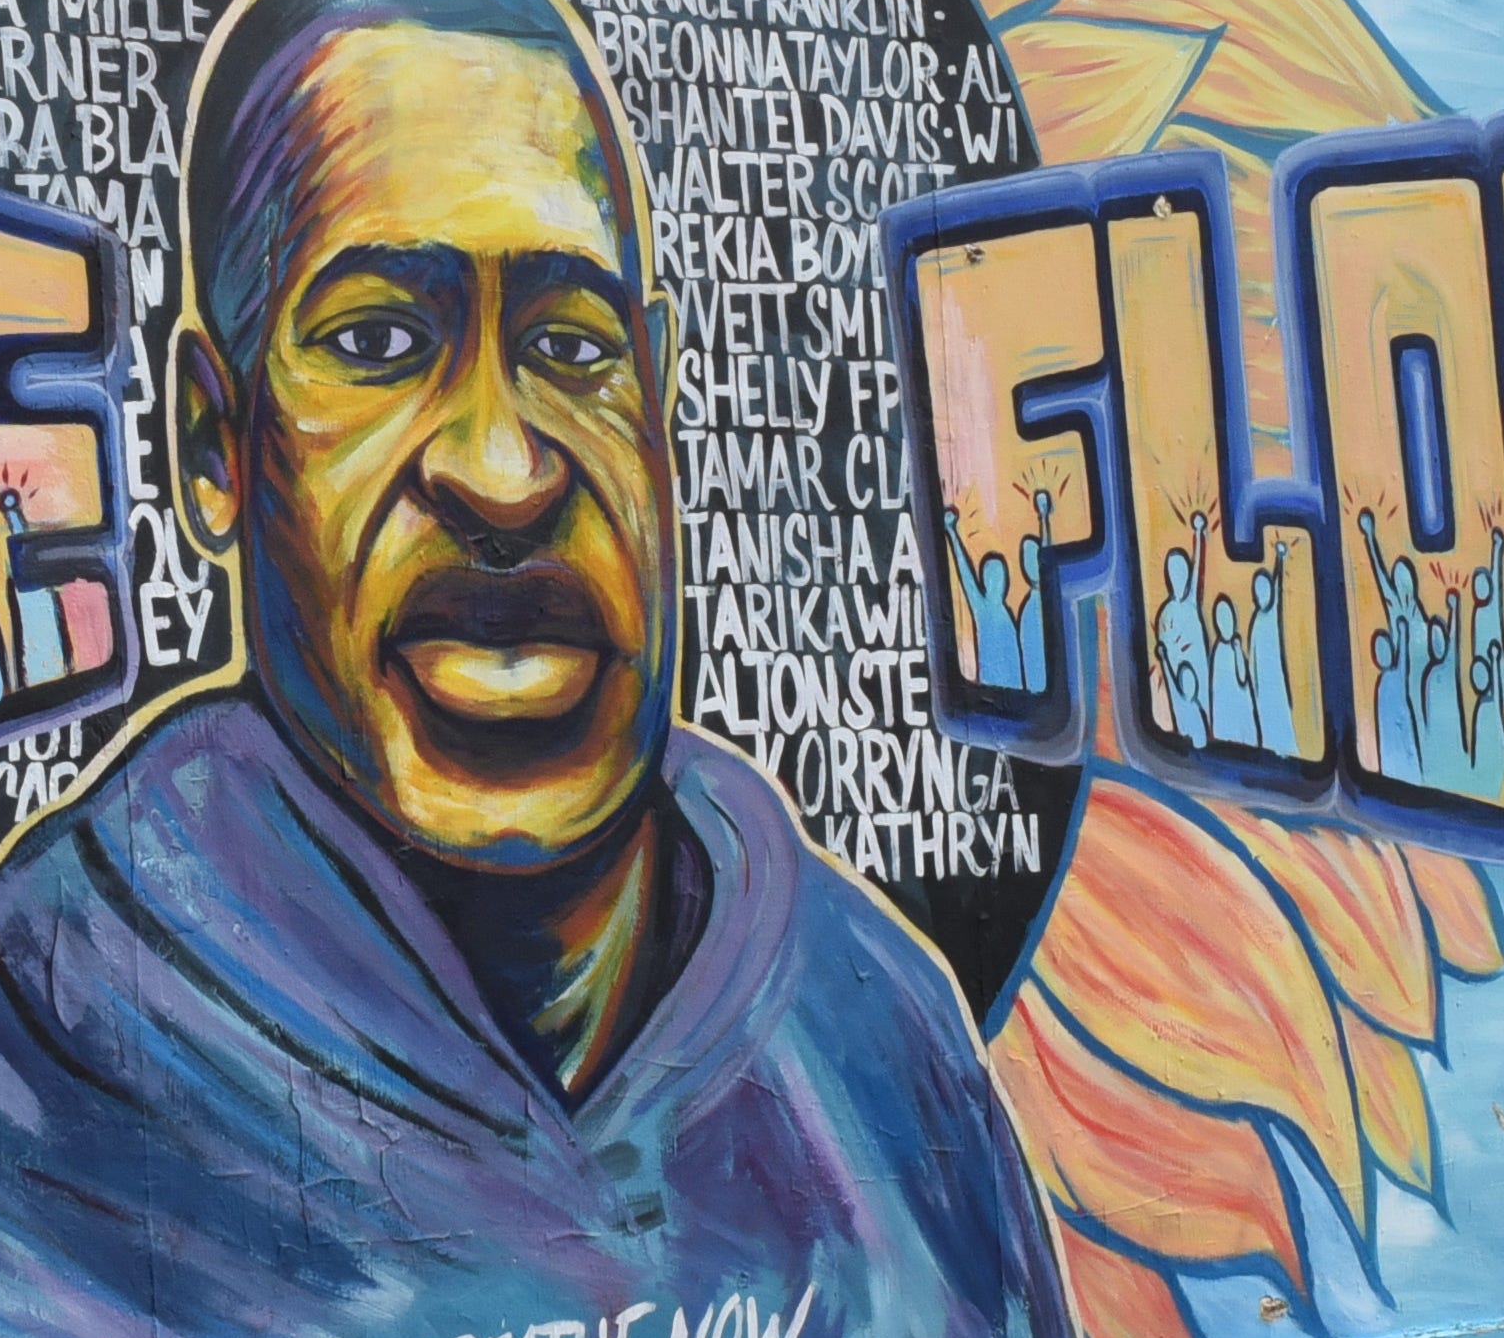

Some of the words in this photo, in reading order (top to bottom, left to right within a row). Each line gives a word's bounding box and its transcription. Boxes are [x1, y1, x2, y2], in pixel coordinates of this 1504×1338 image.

[593, 10, 792, 89] BREONNA
[786, 31, 945, 104] TAYLOR
[959, 44, 1012, 103] AL
[77, 103, 181, 178] BLA
[621, 77, 820, 157] SHANTEL
[820, 93, 942, 162] DAVIS
[955, 103, 1019, 164] WI
[637, 142, 824, 220] WALTER
[825, 157, 957, 223] SCOTT
[652, 210, 782, 281] REKIA
[802, 283, 884, 360] SMI
[677, 348, 833, 437] SHELLY
[673, 429, 837, 512] JAMAR
[680, 512, 878, 586] TANISHA
[685, 584, 855, 652] TARIKA
[693, 651, 840, 735] ALTON
[842, 649, 929, 729] STE
[825, 811, 1041, 883] KATHRYN
